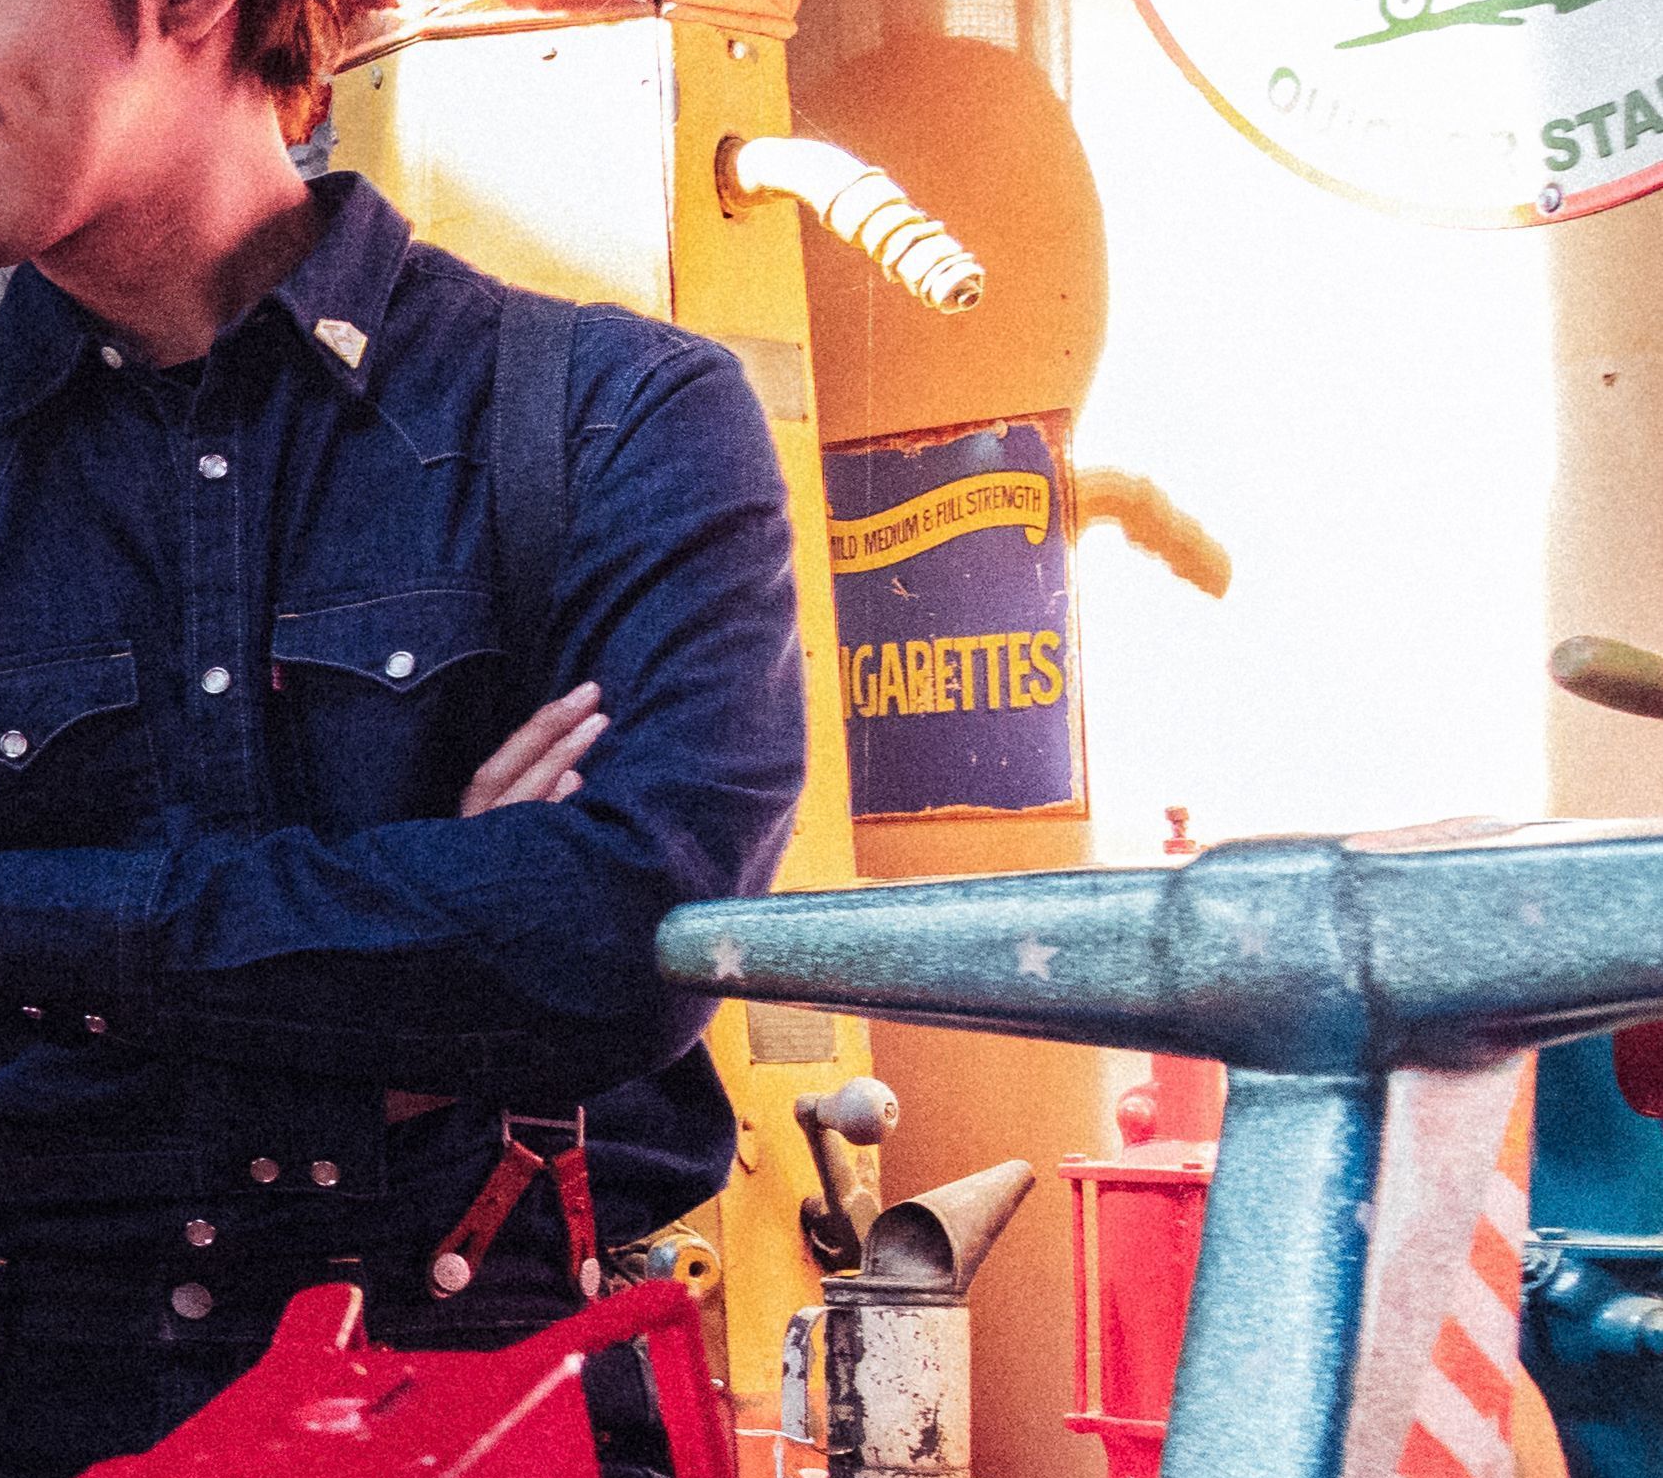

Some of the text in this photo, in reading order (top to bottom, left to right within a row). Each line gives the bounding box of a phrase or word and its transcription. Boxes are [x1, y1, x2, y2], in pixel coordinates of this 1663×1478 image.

[864, 516, 920, 555] MEDIUM
[935, 500, 964, 528] FULL
[965, 483, 1042, 516] STRENGTH
